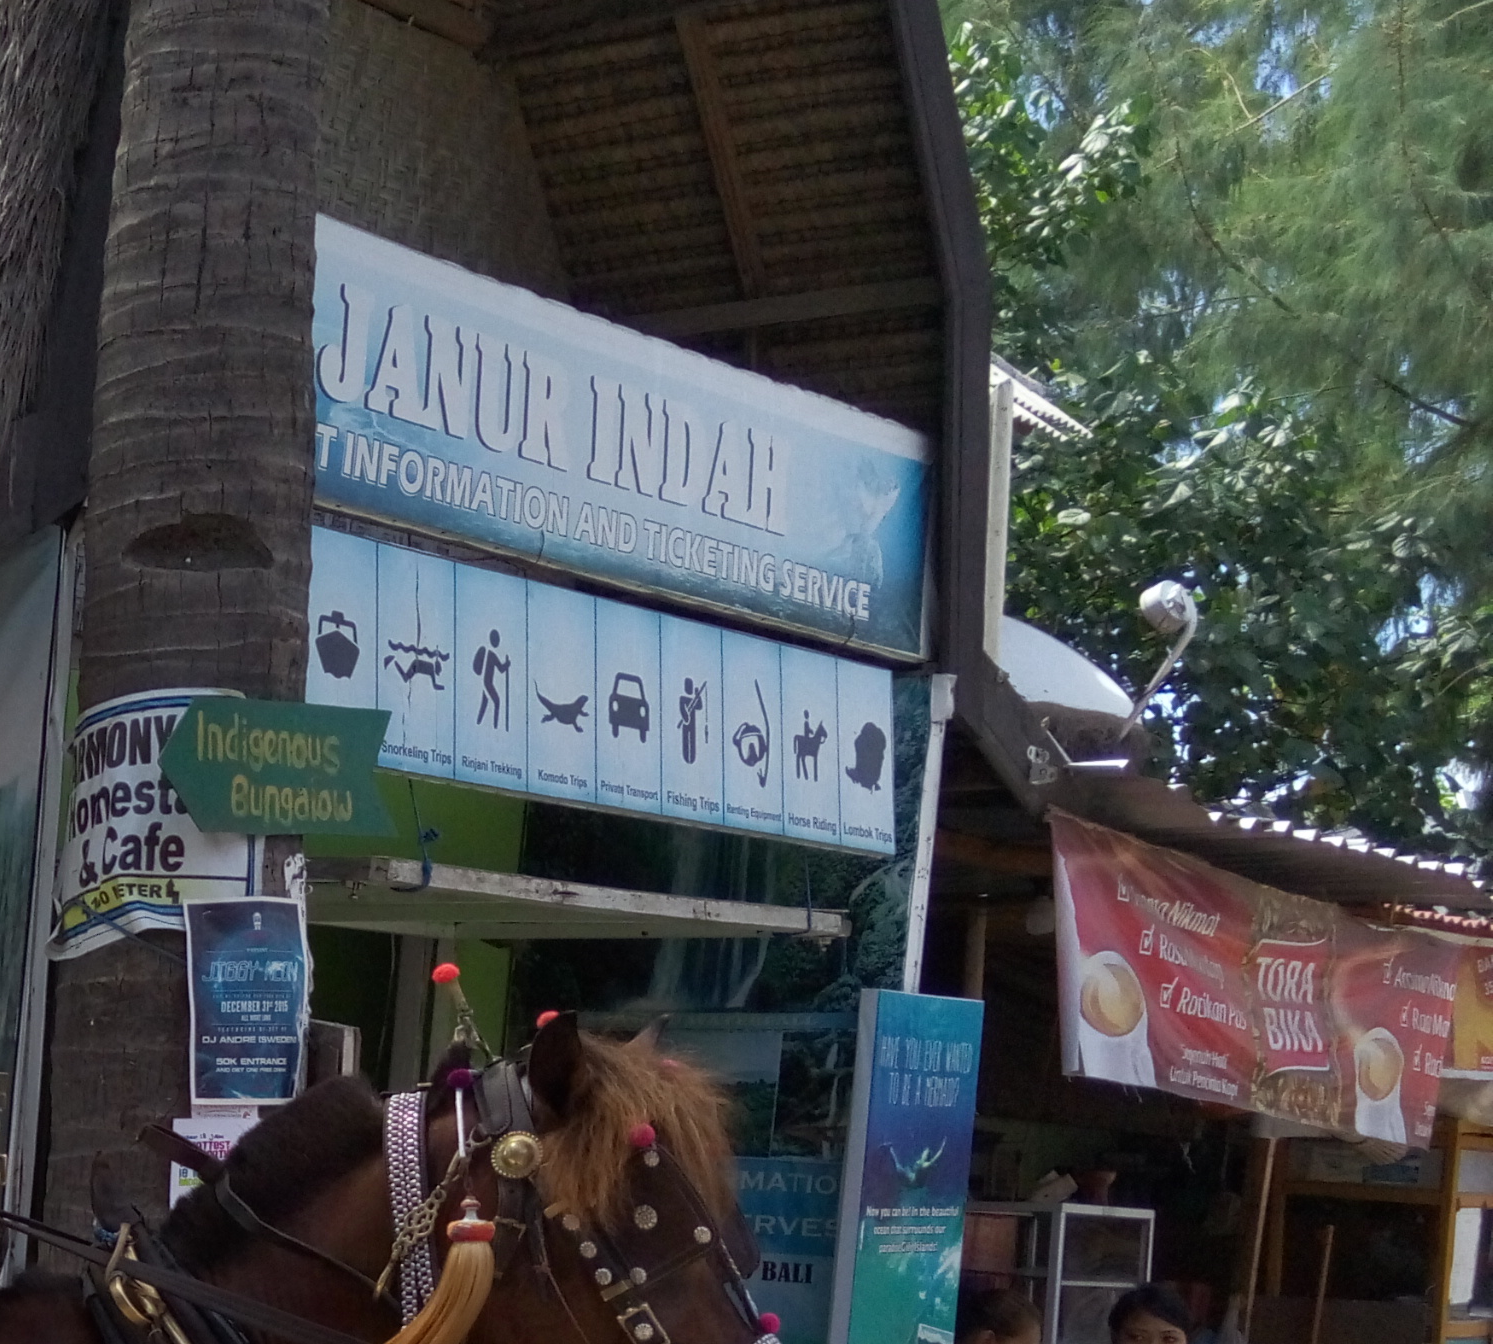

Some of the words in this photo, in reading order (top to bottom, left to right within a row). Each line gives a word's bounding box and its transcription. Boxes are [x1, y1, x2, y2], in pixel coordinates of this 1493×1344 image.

[317, 283, 569, 472] JANUR
[587, 375, 789, 537] INDAH
[341, 430, 571, 538] INFORMATION
[574, 502, 638, 554] AND
[644, 518, 776, 596] TICKETING
[779, 560, 871, 621] SERVICE
[196, 709, 341, 775] Indigenous
[380, 742, 429, 764] Snorkeling
[431, 748, 452, 767] Trips
[461, 755, 488, 772] Rinjani
[490, 760, 522, 780] Trekking
[537, 769, 567, 785] Komodo
[569, 774, 588, 790] Trips
[230, 774, 353, 826] Bungalow
[601, 781, 624, 797] Private
[626, 784, 659, 801] Transport
[666, 790, 697, 811] Fishing
[699, 796, 720, 814] Trips
[726, 803, 749, 819] Renting
[751, 807, 781, 822] Equipment
[788, 812, 811, 829] Horse
[813, 818, 836, 836] Riding
[843, 822, 872, 839] Lombok
[874, 827, 893, 844] Trips
[101, 822, 185, 875] Cafe
[1256, 957, 1318, 1005] TORA
[220, 1000, 261, 1013] DECEMBER
[202, 1035, 217, 1044] DJ
[219, 1035, 257, 1044] ANDRE
[1263, 1007, 1324, 1054] BIKA
[240, 1057, 287, 1065] ENTRANCE
[880, 1036, 900, 1069] HAVE
[905, 1037, 922, 1071] YOU
[924, 1039, 943, 1072] EVER
[946, 1041, 973, 1074] WANTED
[889, 1072, 900, 1105] TO
[902, 1073, 912, 1106] BE
[915, 1074, 922, 1106] A
[880, 1207, 891, 1220] you
[892, 1208, 901, 1217] can
[932, 1205, 959, 1217] beautiful
[744, 1214, 837, 1238] RVES
[761, 1260, 813, 1284] BALI
